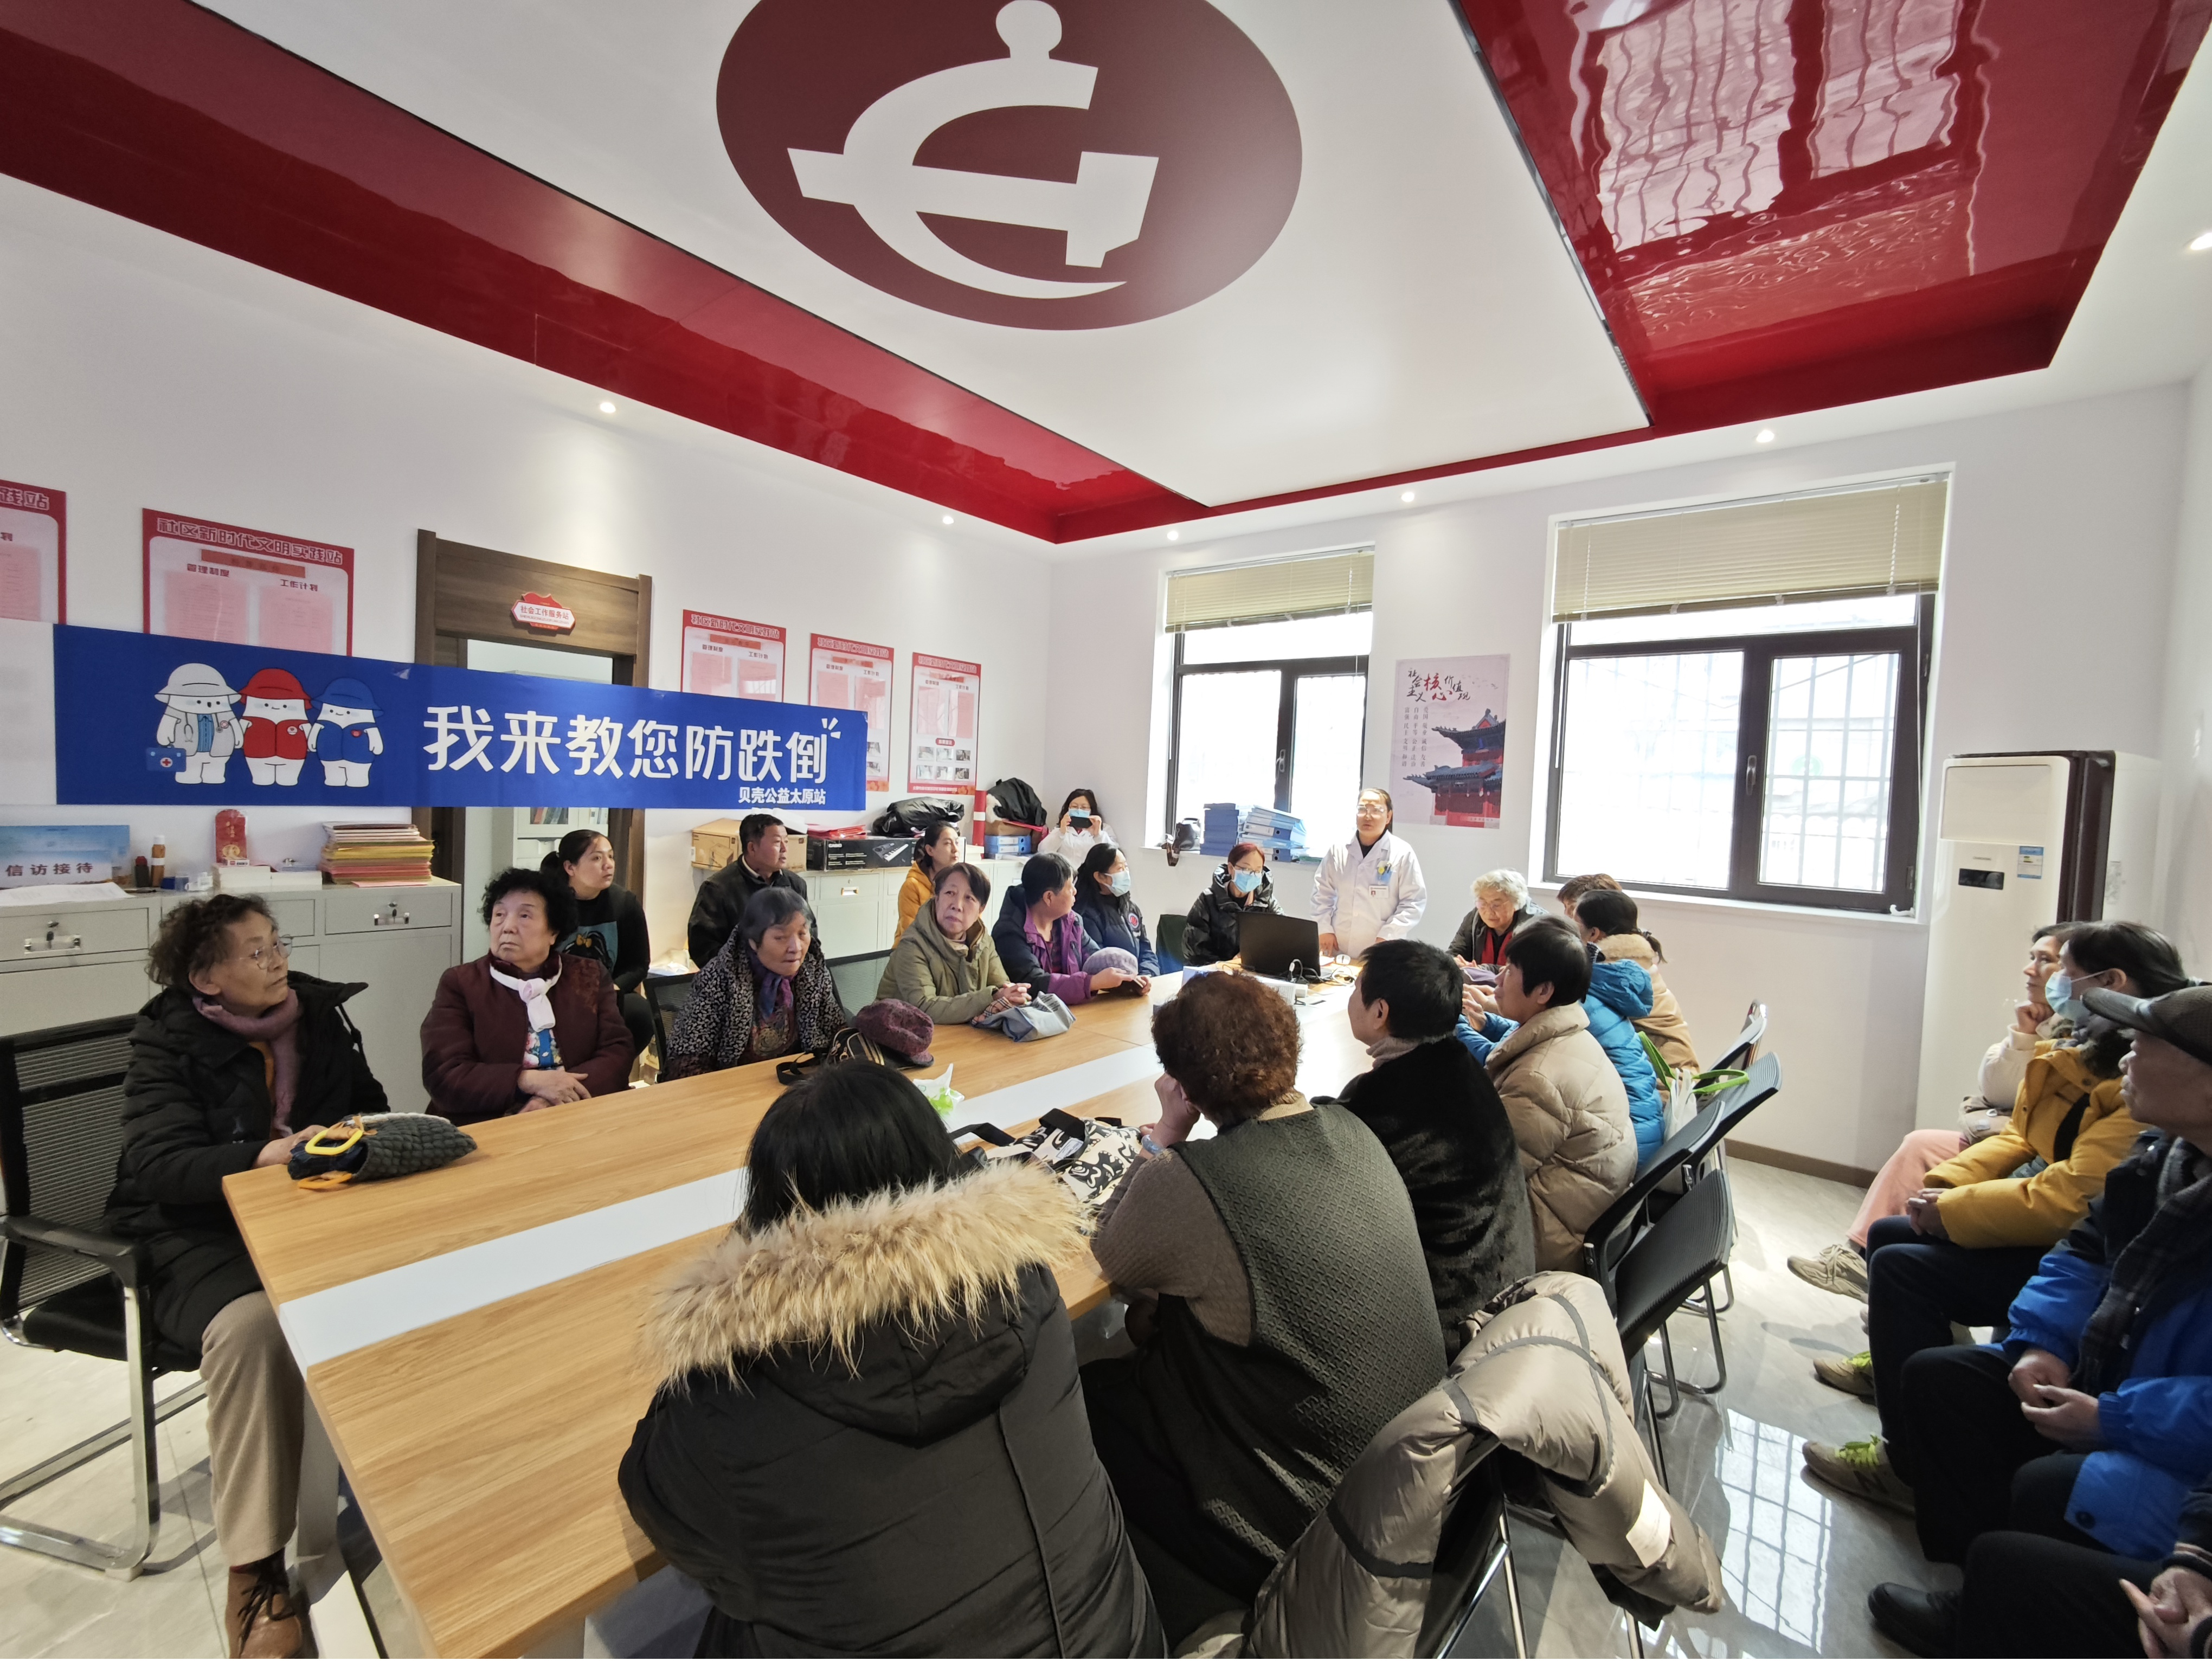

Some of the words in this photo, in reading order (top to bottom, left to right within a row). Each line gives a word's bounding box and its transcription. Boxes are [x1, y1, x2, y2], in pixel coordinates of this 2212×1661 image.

[157, 517, 343, 565] 社区新时代文明实践站
[187, 563, 230, 577] 管理制度
[280, 578, 318, 592] 工作计划
[520, 605, 569, 620] 社会工作服务站
[691, 614, 780, 639] 社区新时代文明实践站
[817, 636, 889, 658] 社区新时代文明实践站
[423, 705, 827, 784] 我来教您防跌倒
[738, 787, 826, 805] 贝壳公益太原站
[6, 862, 93, 877] 信访接待
